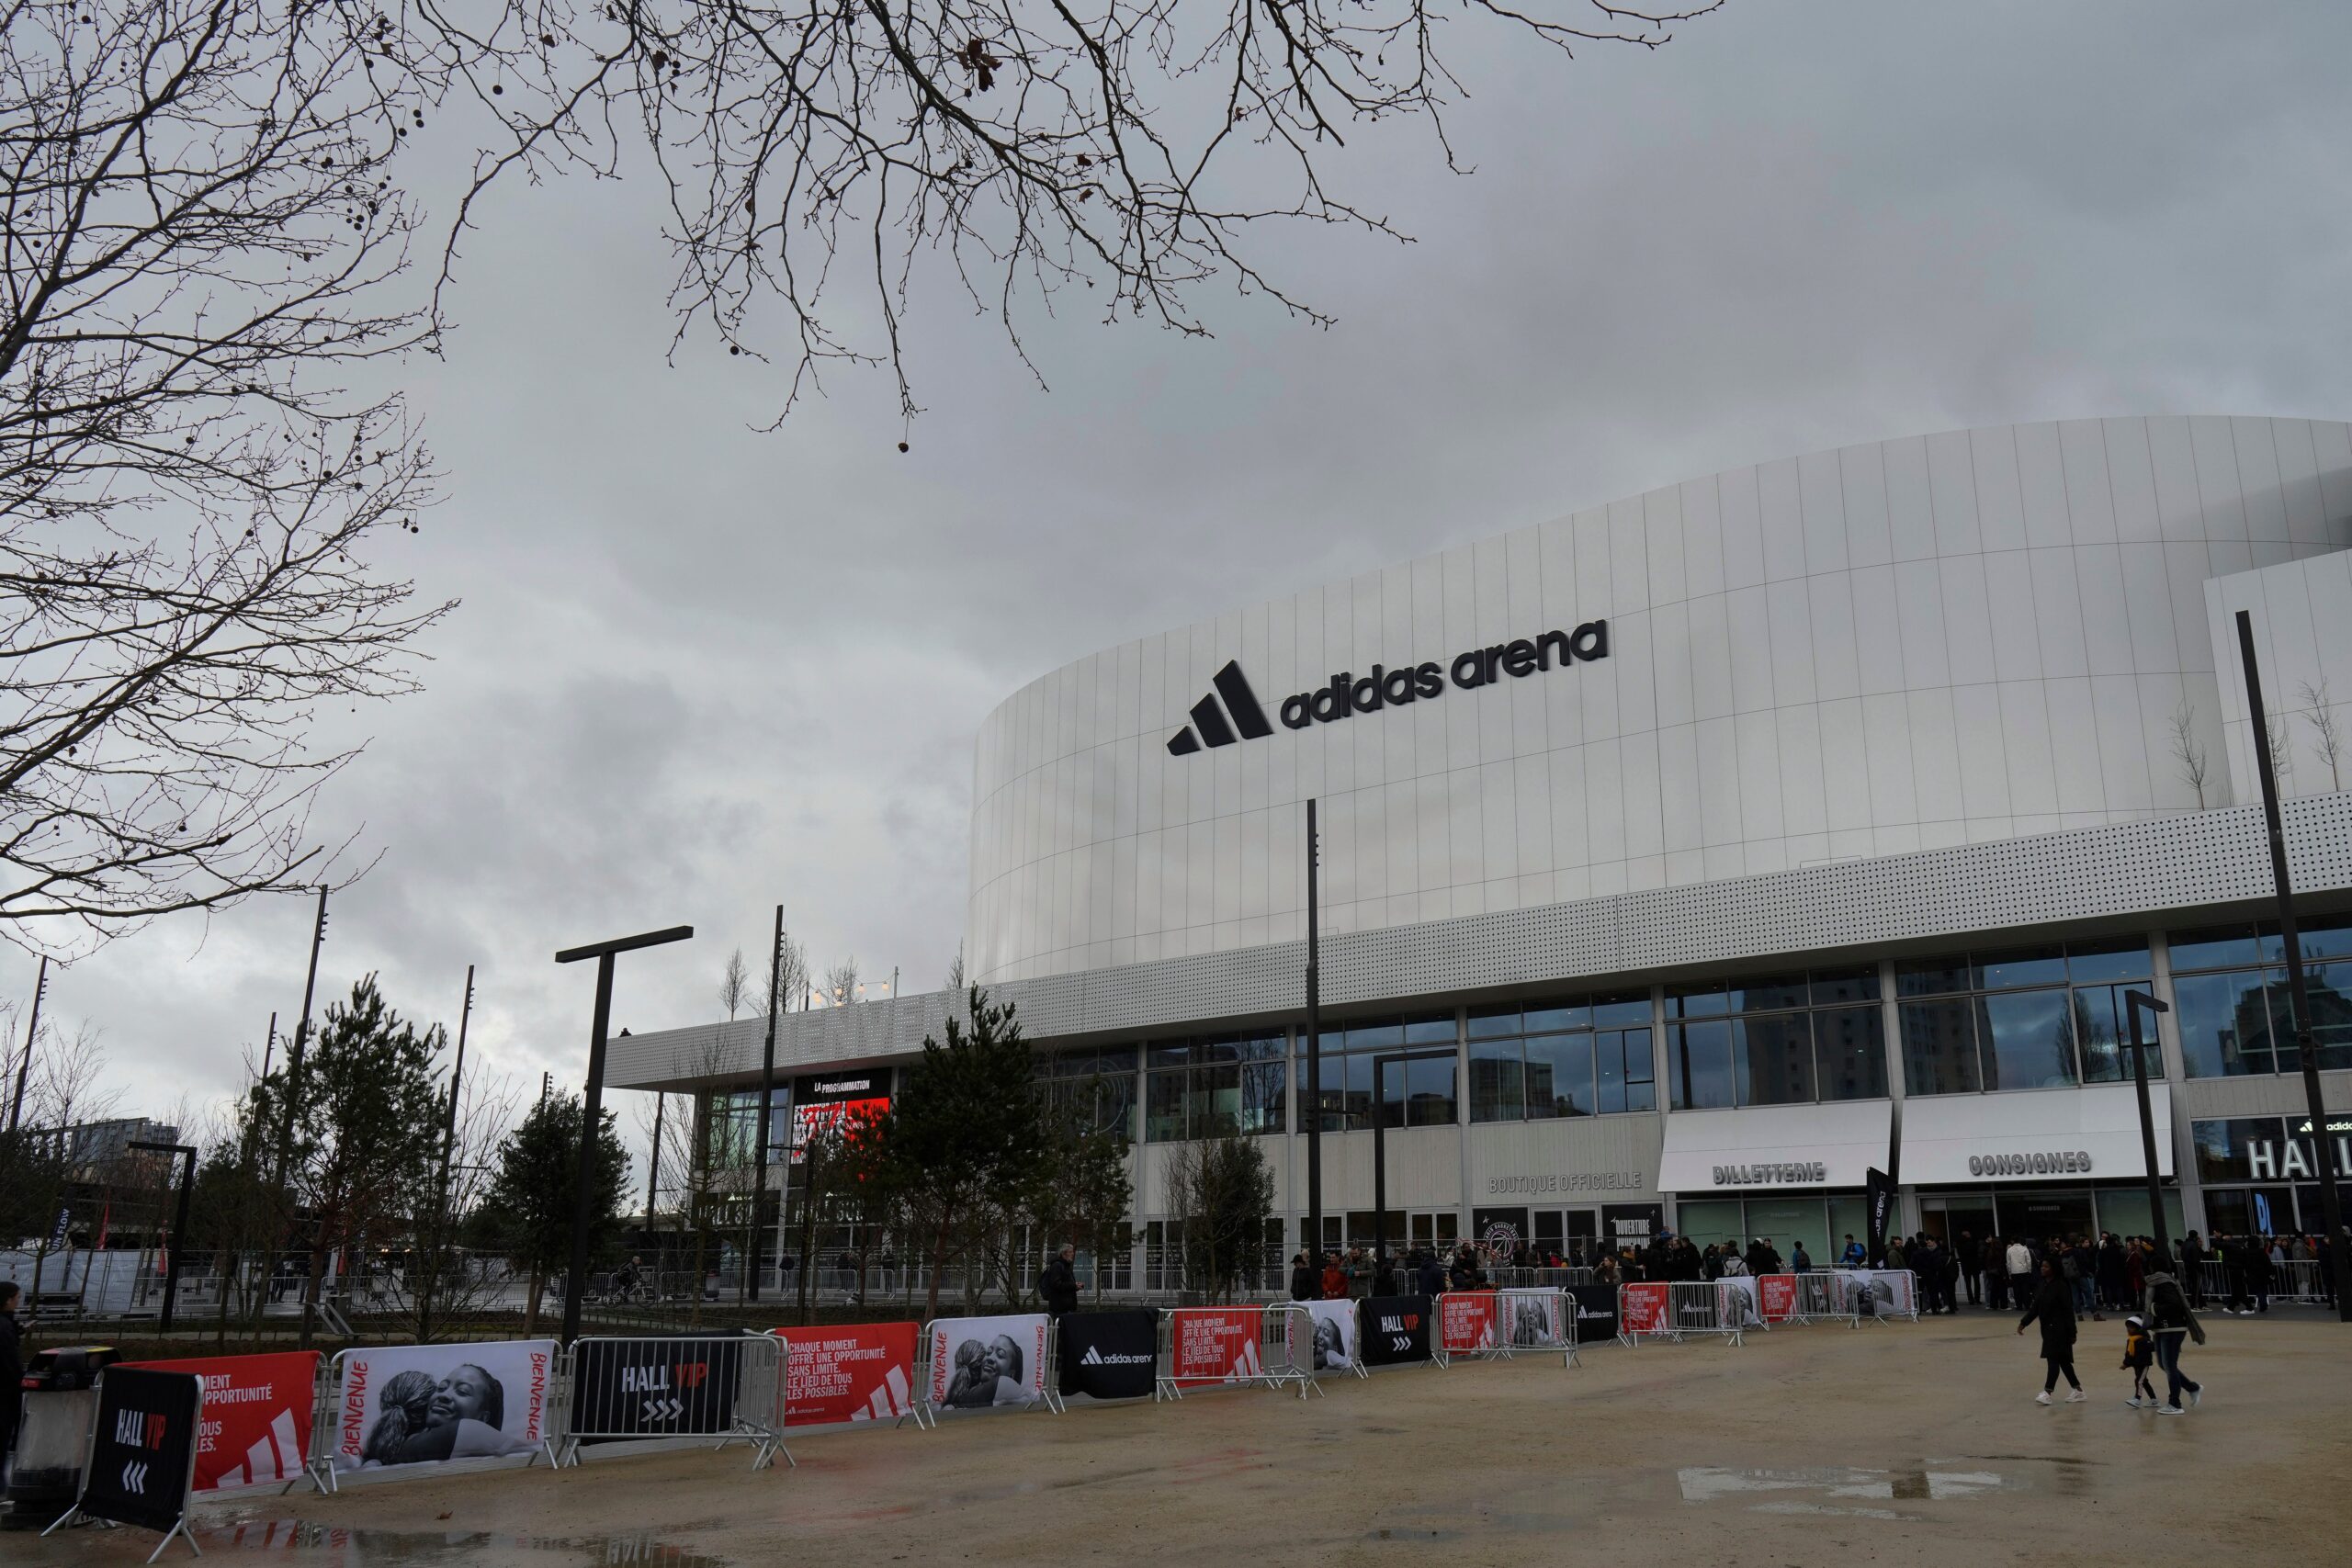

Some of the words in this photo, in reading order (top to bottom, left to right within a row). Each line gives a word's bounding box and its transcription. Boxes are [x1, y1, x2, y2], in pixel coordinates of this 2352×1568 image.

[1280, 660, 1443, 730] adidas
[1450, 619, 1610, 691] arena
[814, 1081, 821, 1092] LA
[821, 1079, 870, 1094] PROGRAMMATION
[1969, 1151, 2091, 1177] CONSIGNES
[2246, 1136, 2352, 1179] HAL
[1489, 1175, 1556, 1194] BOUTIQUE
[1559, 1172, 1642, 1191] OFFICIELLE
[1713, 1162, 1826, 1185] BILLETTERIE
[1616, 1219, 1650, 1235] OUVERTURE
[1381, 1315, 1404, 1333] HALL
[1403, 1314, 1419, 1331] VIP
[787, 1353, 815, 1365] OFFRE
[817, 1352, 832, 1363] UNE
[834, 1346, 886, 1362] OPPORTUNITÉ
[788, 1342, 821, 1355] CHAQUE
[823, 1339, 857, 1351] MOMENT
[787, 1365, 810, 1377] SANS
[812, 1362, 841, 1375] LIMITE.
[933, 1331, 947, 1403] BIENVENUE
[1103, 1353, 1132, 1364] adidas
[621, 1365, 670, 1393] HALL
[675, 1362, 707, 1389] VIP
[787, 1377, 800, 1389] LE
[800, 1375, 820, 1388] LIEU
[821, 1375, 832, 1386] DE
[833, 1372, 853, 1384] TOUS
[202, 1382, 273, 1405] PPORTUNITÉ
[526, 1352, 548, 1441] BIENVENUE
[787, 1389, 802, 1400] LES
[805, 1385, 850, 1399] POSSIBLES.
[341, 1360, 368, 1457] BIENVENUE
[115, 1408, 144, 1448] HALL
[146, 1412, 168, 1451] VIP
[198, 1420, 222, 1438] OUS
